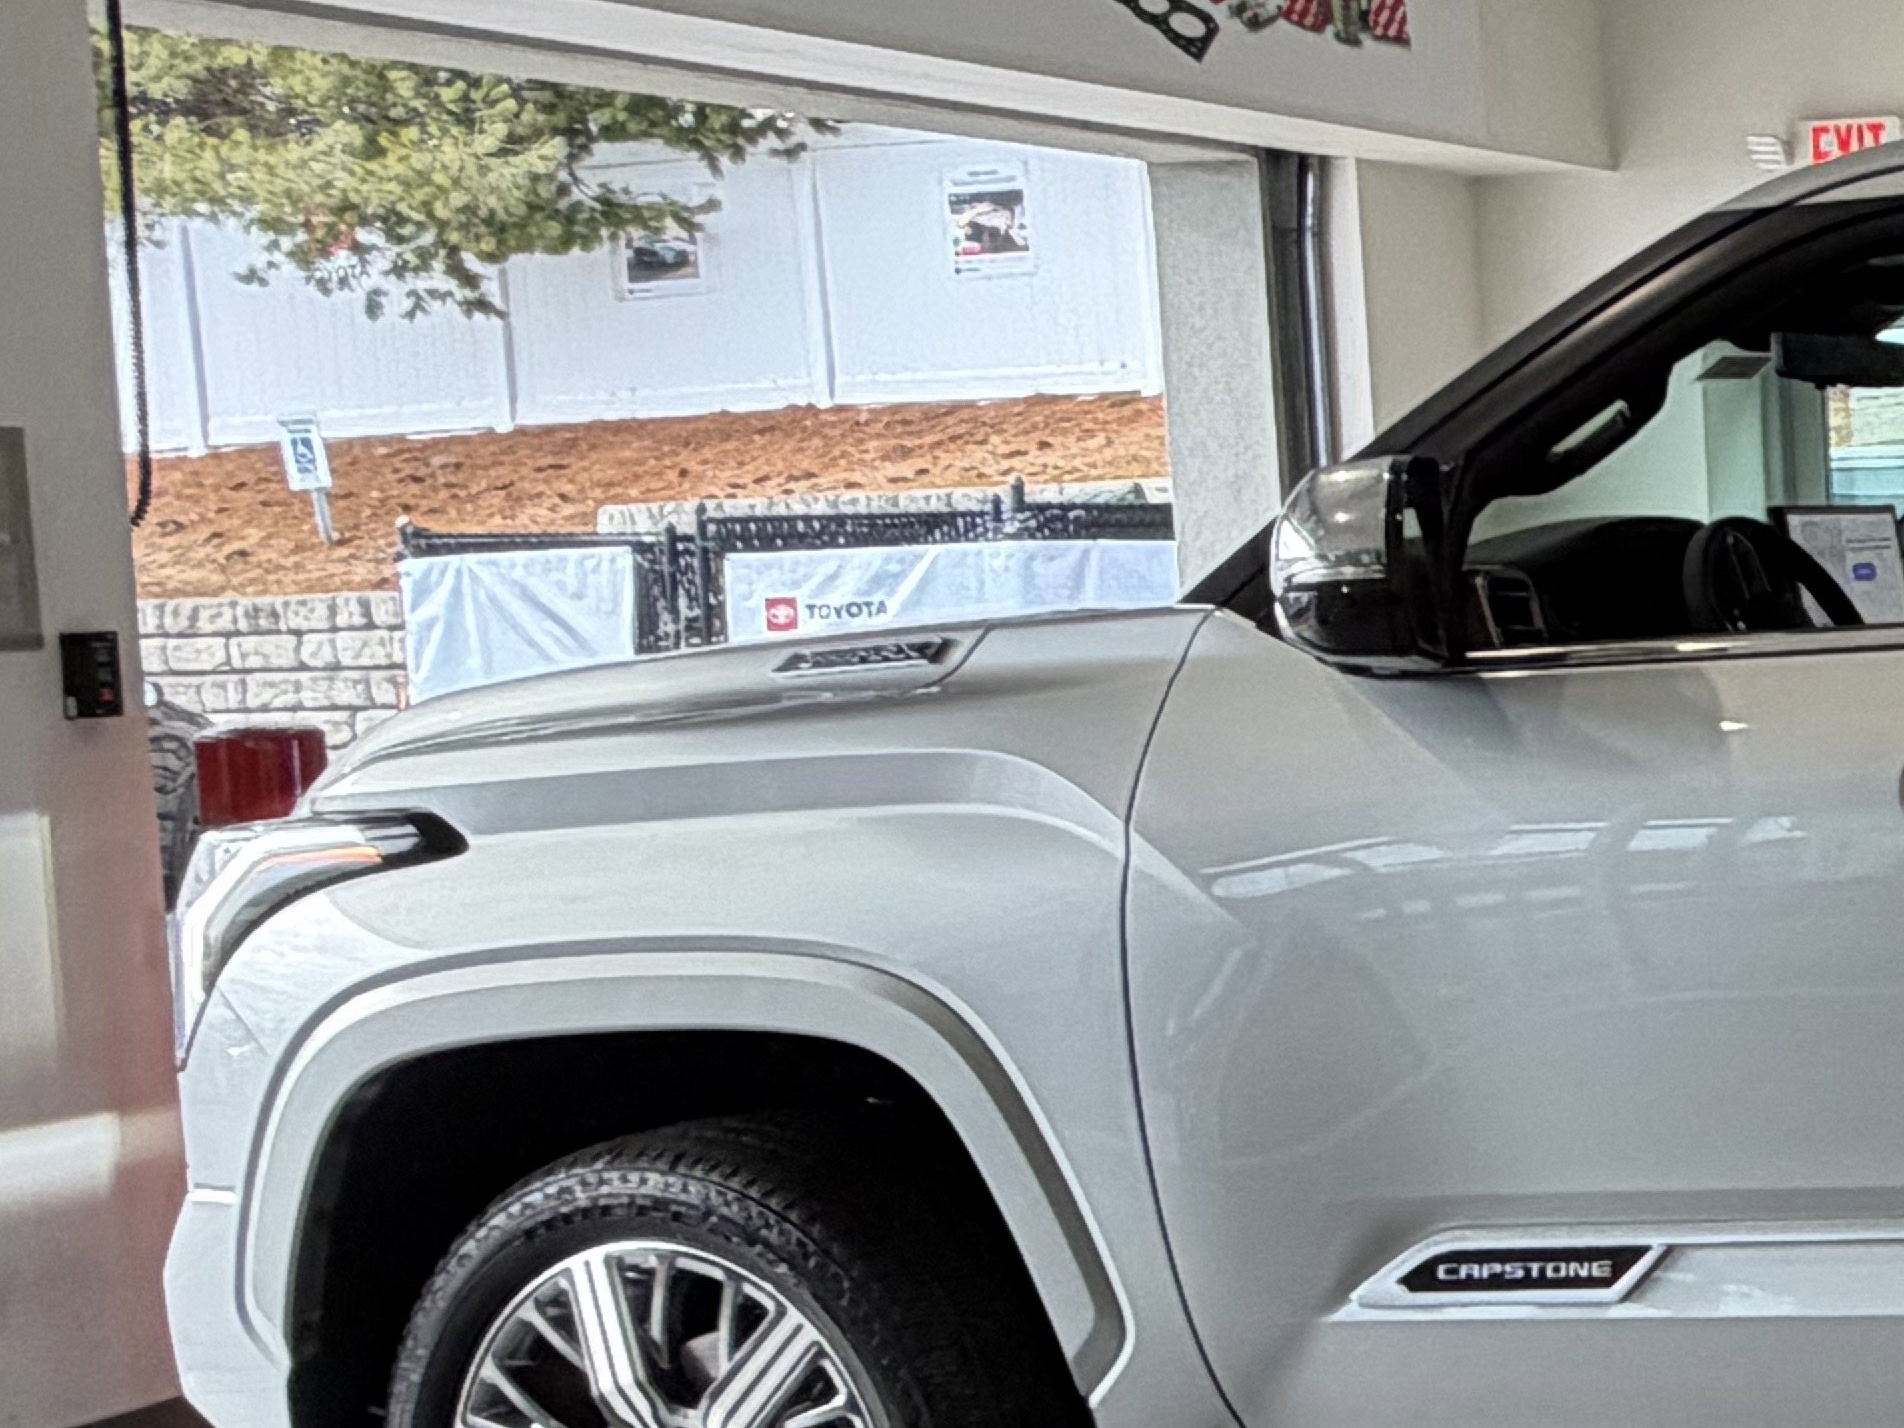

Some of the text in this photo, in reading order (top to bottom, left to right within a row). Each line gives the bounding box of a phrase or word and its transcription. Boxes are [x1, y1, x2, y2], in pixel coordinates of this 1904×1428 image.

[1811, 122, 1887, 164] EXIT
[805, 600, 888, 620] TOYOTA
[1436, 1260, 1614, 1282] CAPSTONE
